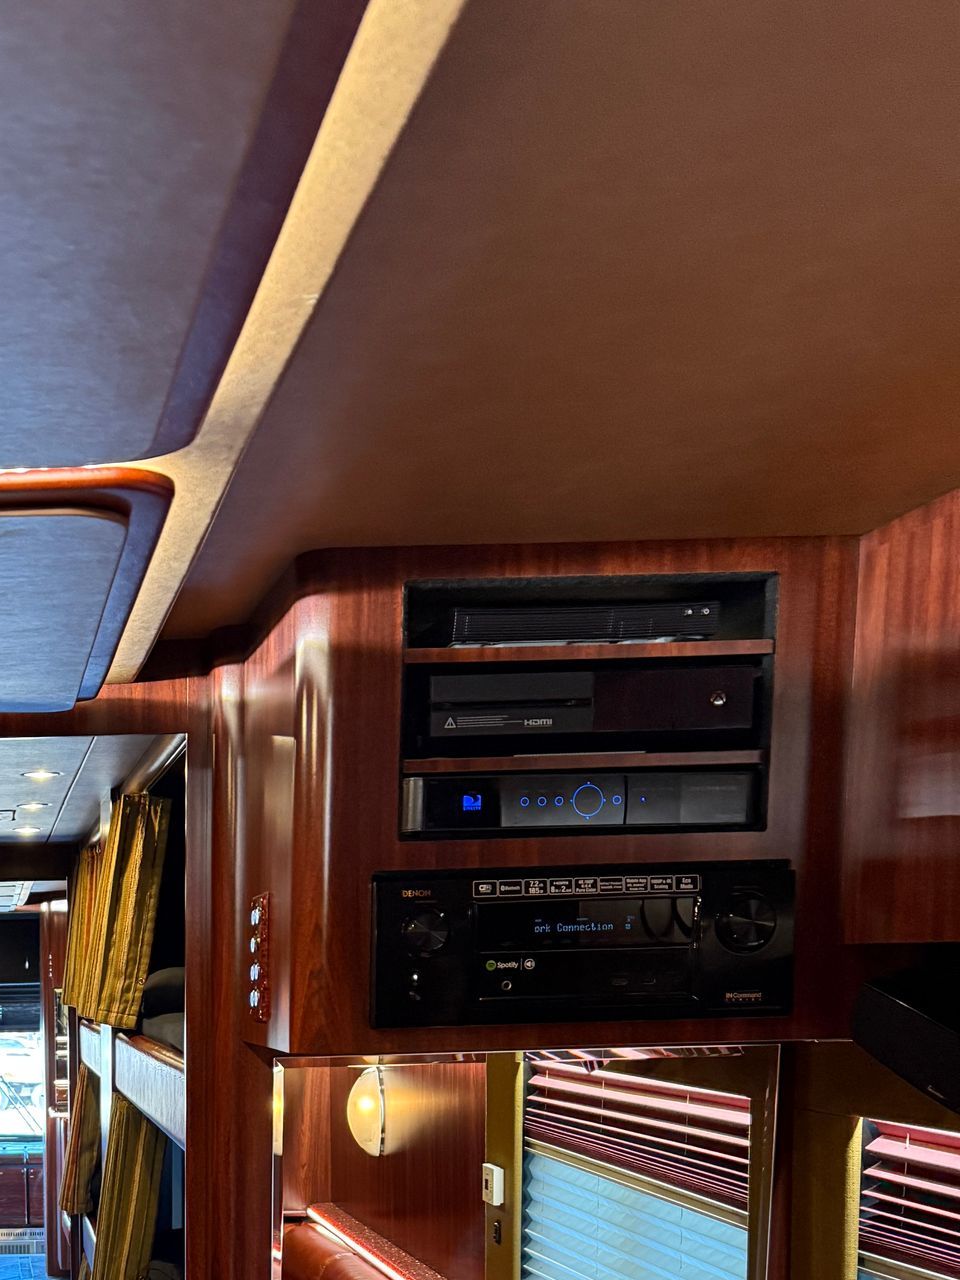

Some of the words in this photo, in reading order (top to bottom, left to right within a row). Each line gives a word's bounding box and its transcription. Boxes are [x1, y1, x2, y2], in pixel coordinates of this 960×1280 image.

[524, 718, 553, 726] HDMI
[402, 889, 432, 898] DENON
[556, 922, 614, 932] Connection
[496, 961, 519, 969] Spotify
